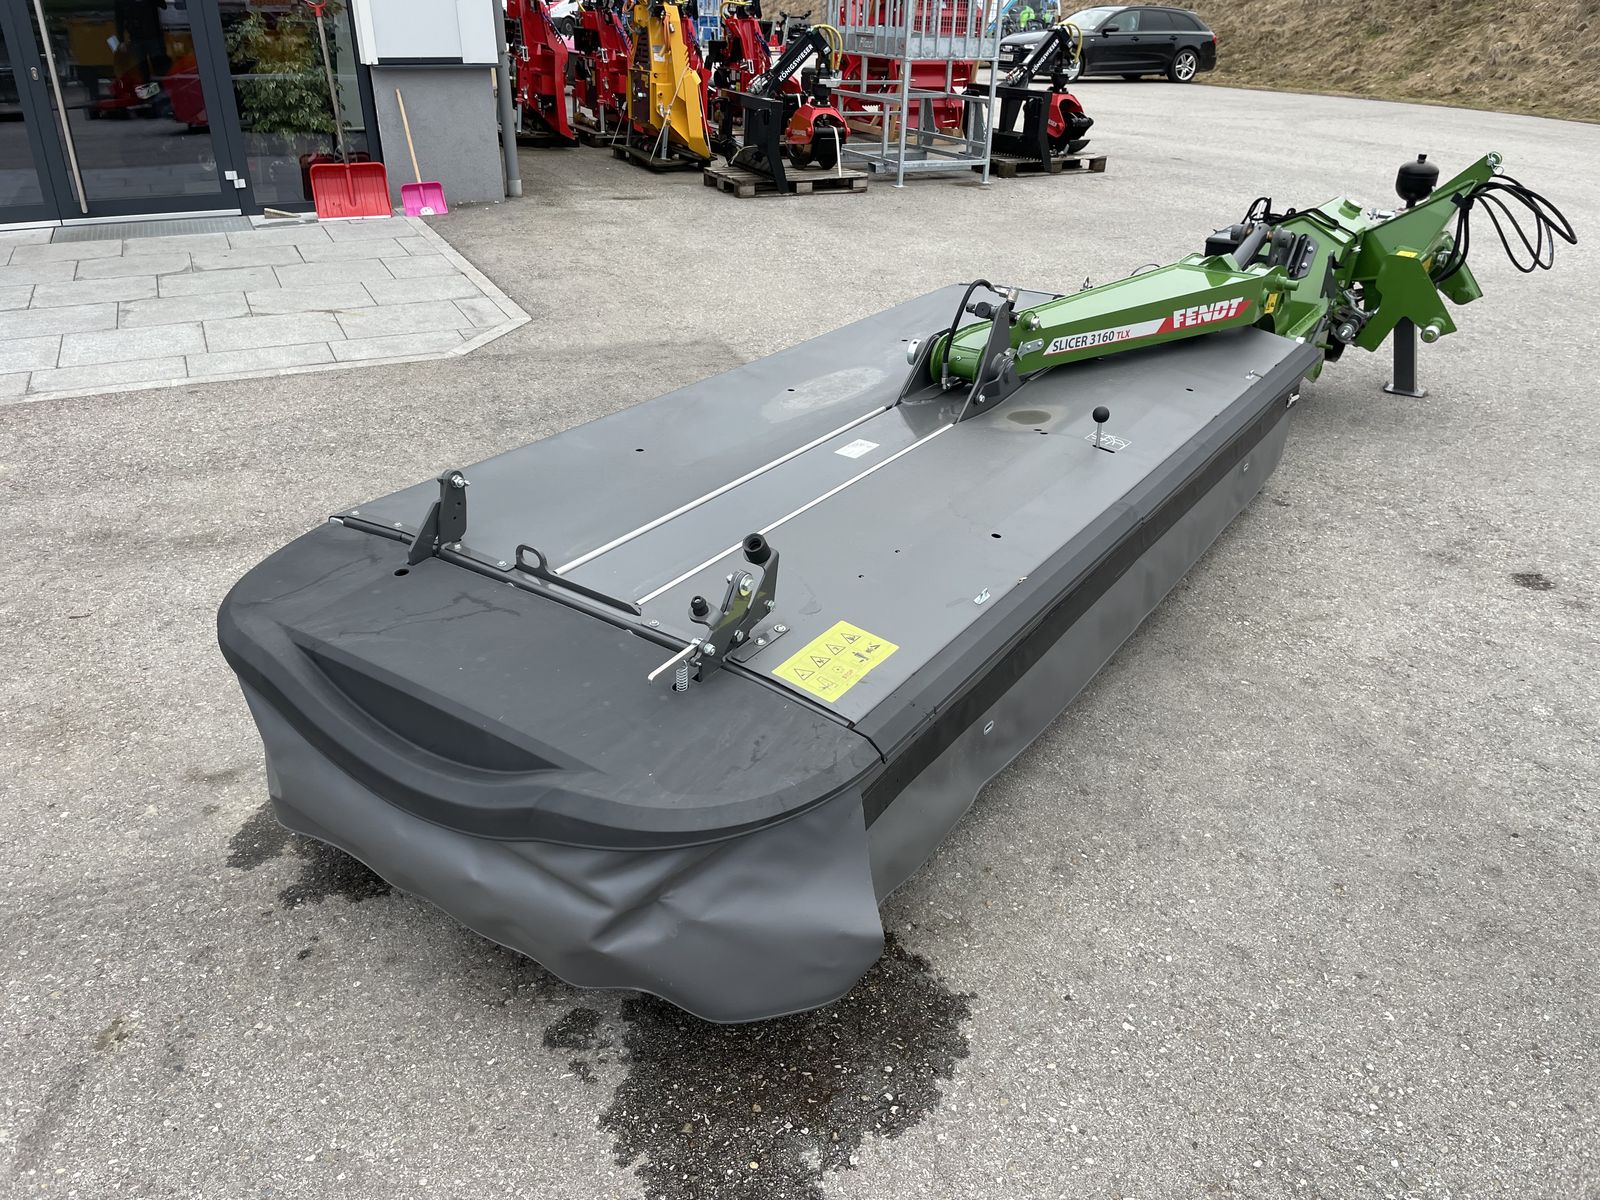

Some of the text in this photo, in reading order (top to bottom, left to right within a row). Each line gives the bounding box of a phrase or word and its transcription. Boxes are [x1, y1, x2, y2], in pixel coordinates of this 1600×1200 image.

[778, 43, 814, 82] KÖNIGSWIESER
[1172, 296, 1244, 329] FENDT
[1052, 328, 1130, 352] SLICER 3160 TLX
